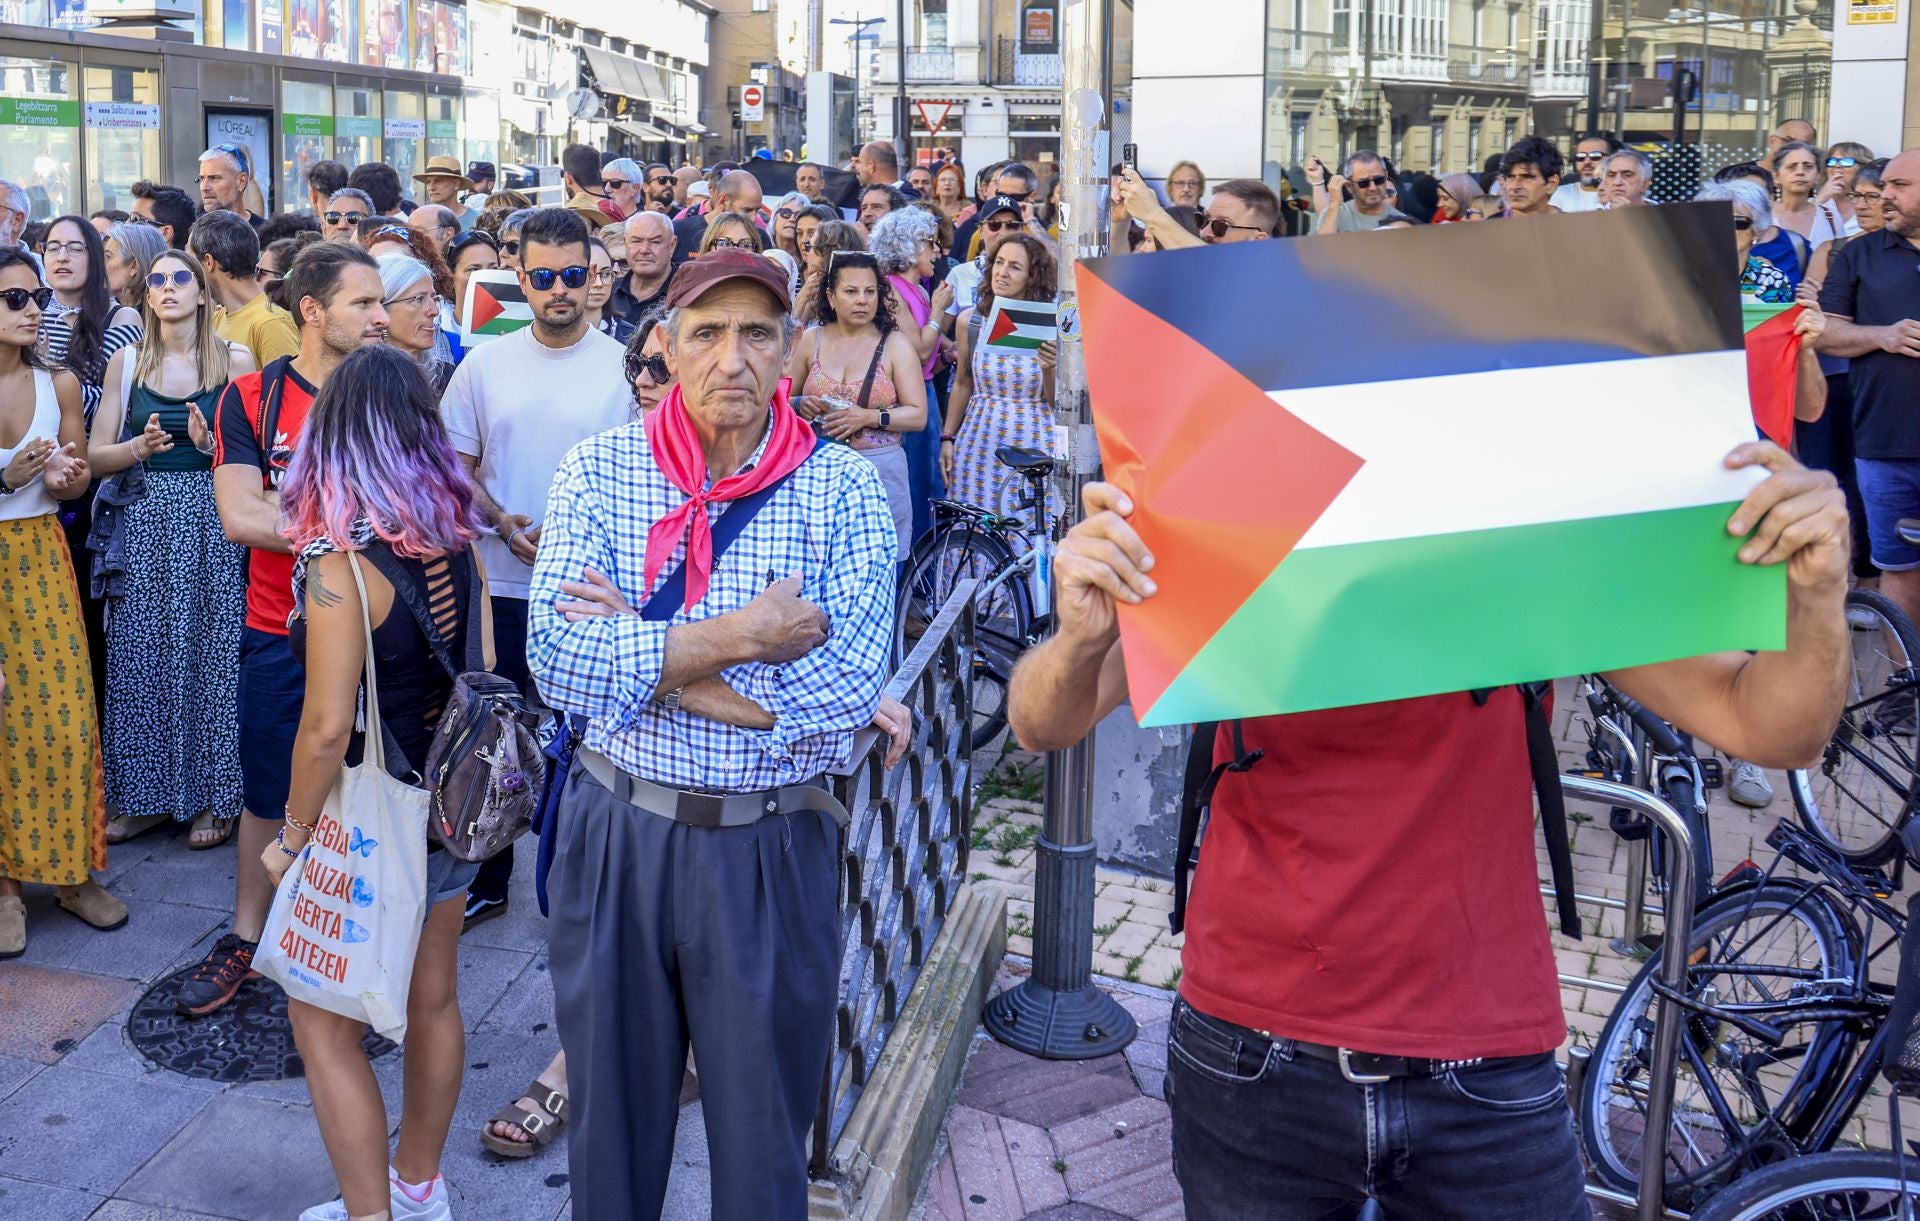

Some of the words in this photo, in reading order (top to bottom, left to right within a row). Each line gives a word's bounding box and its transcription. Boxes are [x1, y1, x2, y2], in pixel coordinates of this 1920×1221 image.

[15, 99, 58, 113] Legebiltzarra
[111, 104, 135, 115] Salburua
[15, 112, 58, 125] Parlamento
[293, 892, 342, 940] GERTA
